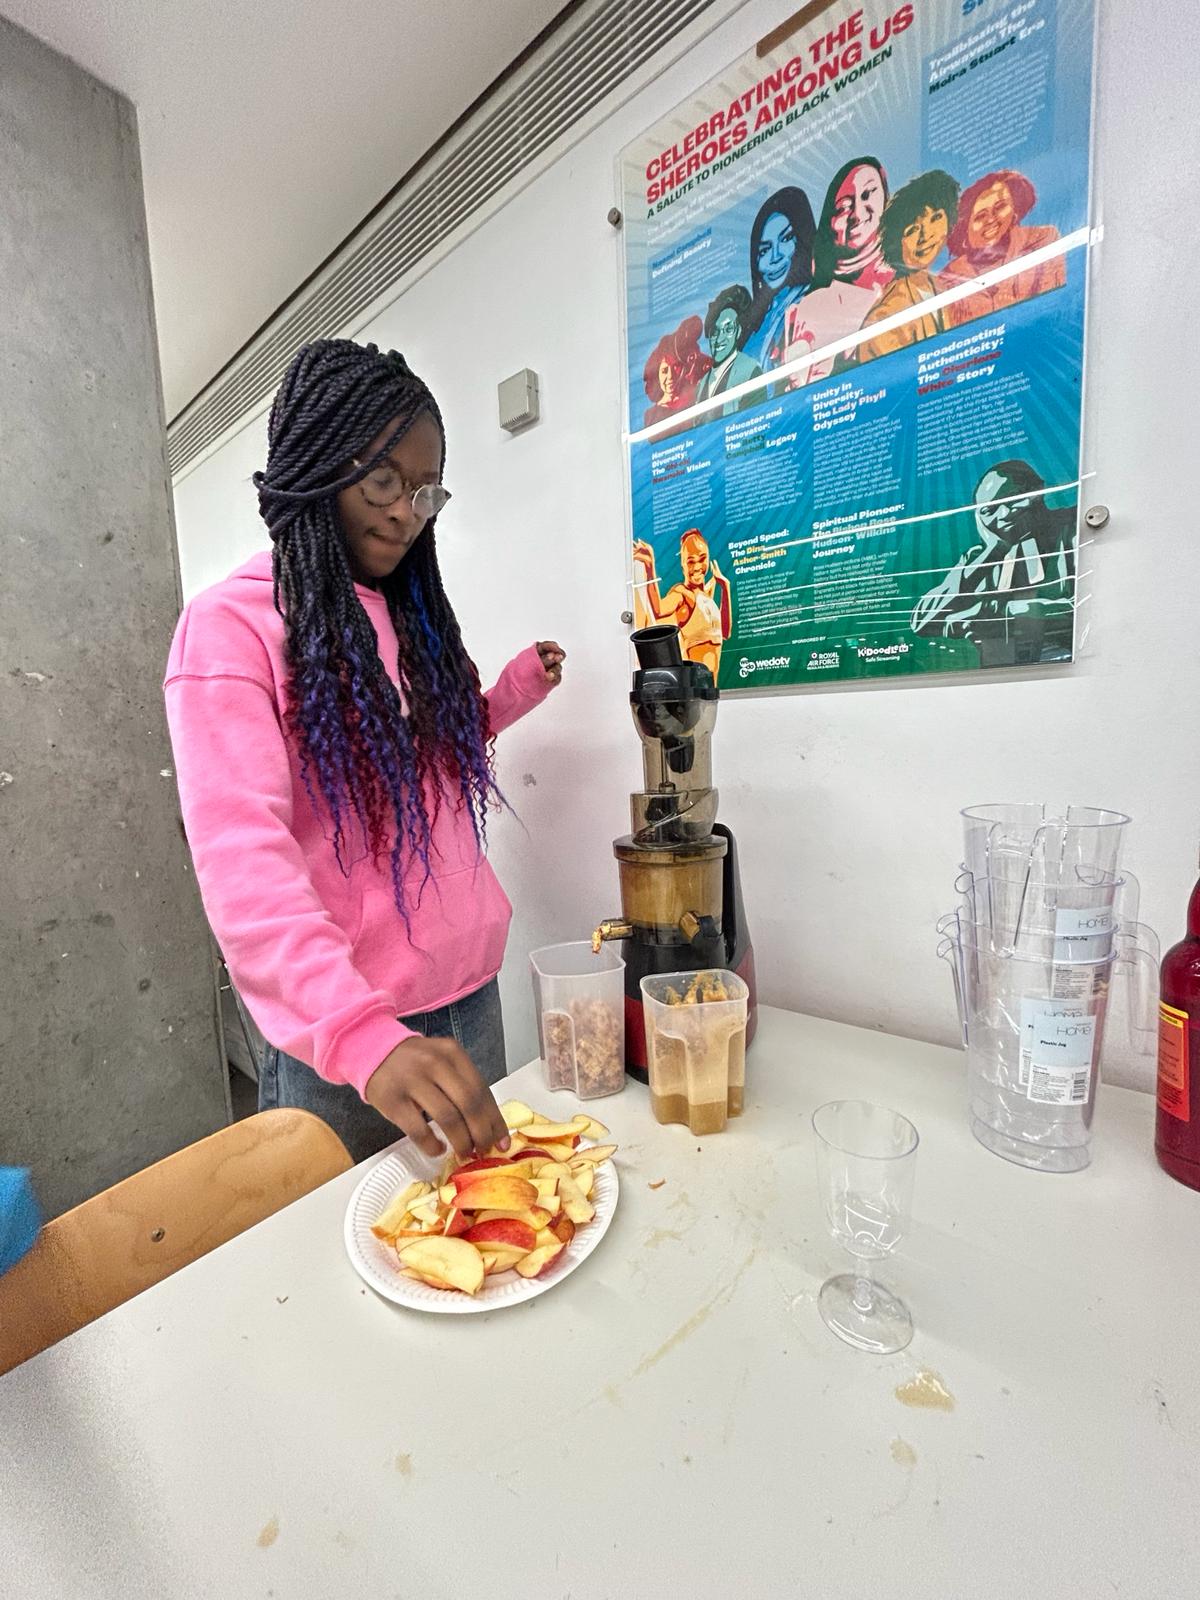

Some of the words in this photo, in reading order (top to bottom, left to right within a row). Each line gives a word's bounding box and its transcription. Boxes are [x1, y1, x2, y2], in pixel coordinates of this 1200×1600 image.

[928, 68, 967, 94] Moira
[970, 36, 1016, 70] Stuart
[1020, 19, 1044, 40] Era
[646, 56, 802, 181] CELEBRATING
[809, 8, 863, 64] THE
[646, 120, 748, 204] SHEROES
[754, 41, 862, 132] AMONG
[870, 4, 914, 50] US
[647, 208, 654, 219] A
[656, 179, 694, 212] SALUTE
[696, 170, 710, 184] TO
[712, 121, 783, 175] PIONEERING
[786, 87, 830, 126] BLACK
[834, 45, 892, 92] WOMEN
[652, 255, 682, 279] Defining
[684, 238, 712, 259] Beauty
[918, 324, 1006, 363] Broadcasting
[918, 338, 1004, 374] Authenticity:
[918, 372, 940, 385] The
[956, 364, 995, 383] Story
[813, 386, 840, 401] Unity
[842, 382, 852, 391] in
[813, 388, 864, 412] Diversity:
[813, 412, 831, 421] The
[833, 400, 856, 415] Lady
[859, 388, 886, 406] Phyll
[725, 415, 764, 433] Educator
[766, 407, 782, 420] and
[813, 412, 856, 432] Odyssey
[725, 423, 770, 442] Innovator:
[766, 432, 797, 448] Legacy
[652, 443, 685, 460] Harmony
[686, 440, 694, 448] in
[726, 442, 740, 451] The
[652, 451, 688, 468] Diversity:
[686, 460, 710, 473] Vision
[652, 467, 665, 476] The
[812, 513, 858, 530] Spiritual
[859, 504, 905, 520] Pioneer:
[728, 536, 758, 550] Beyond
[760, 529, 790, 542] Speed:
[812, 536, 854, 549] Hudson-
[856, 526, 896, 540] Wilkins
[731, 550, 745, 558] The
[746, 544, 765, 554] Dina
[733, 549, 787, 567] Asher-Smith
[812, 544, 855, 558] Journey
[735, 560, 776, 575] Chronicle
[792, 637, 819, 645] SPONSORED
[756, 656, 790, 667] wedotv
[1078, 917, 1108, 928] HOME
[1056, 1026, 1092, 1036] HOME
